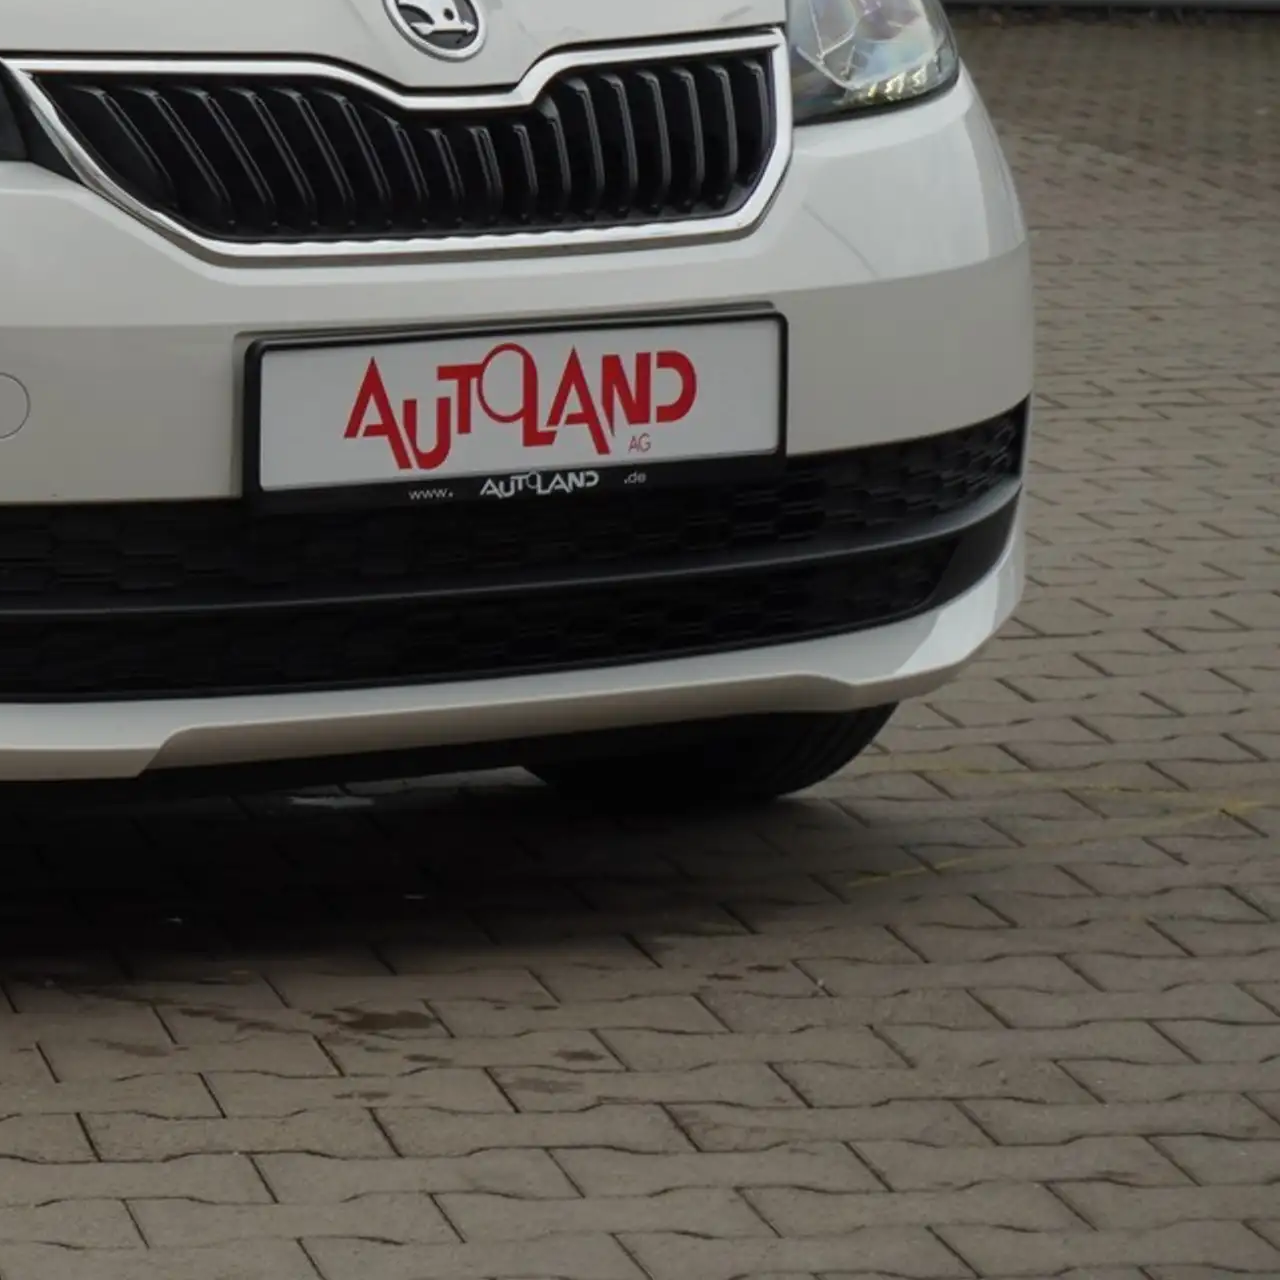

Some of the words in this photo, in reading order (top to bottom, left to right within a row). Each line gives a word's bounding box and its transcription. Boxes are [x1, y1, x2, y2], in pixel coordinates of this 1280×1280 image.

[343, 342, 698, 471] AUTOLAND
[627, 432, 652, 454] AG
[408, 487, 454, 500] www.
